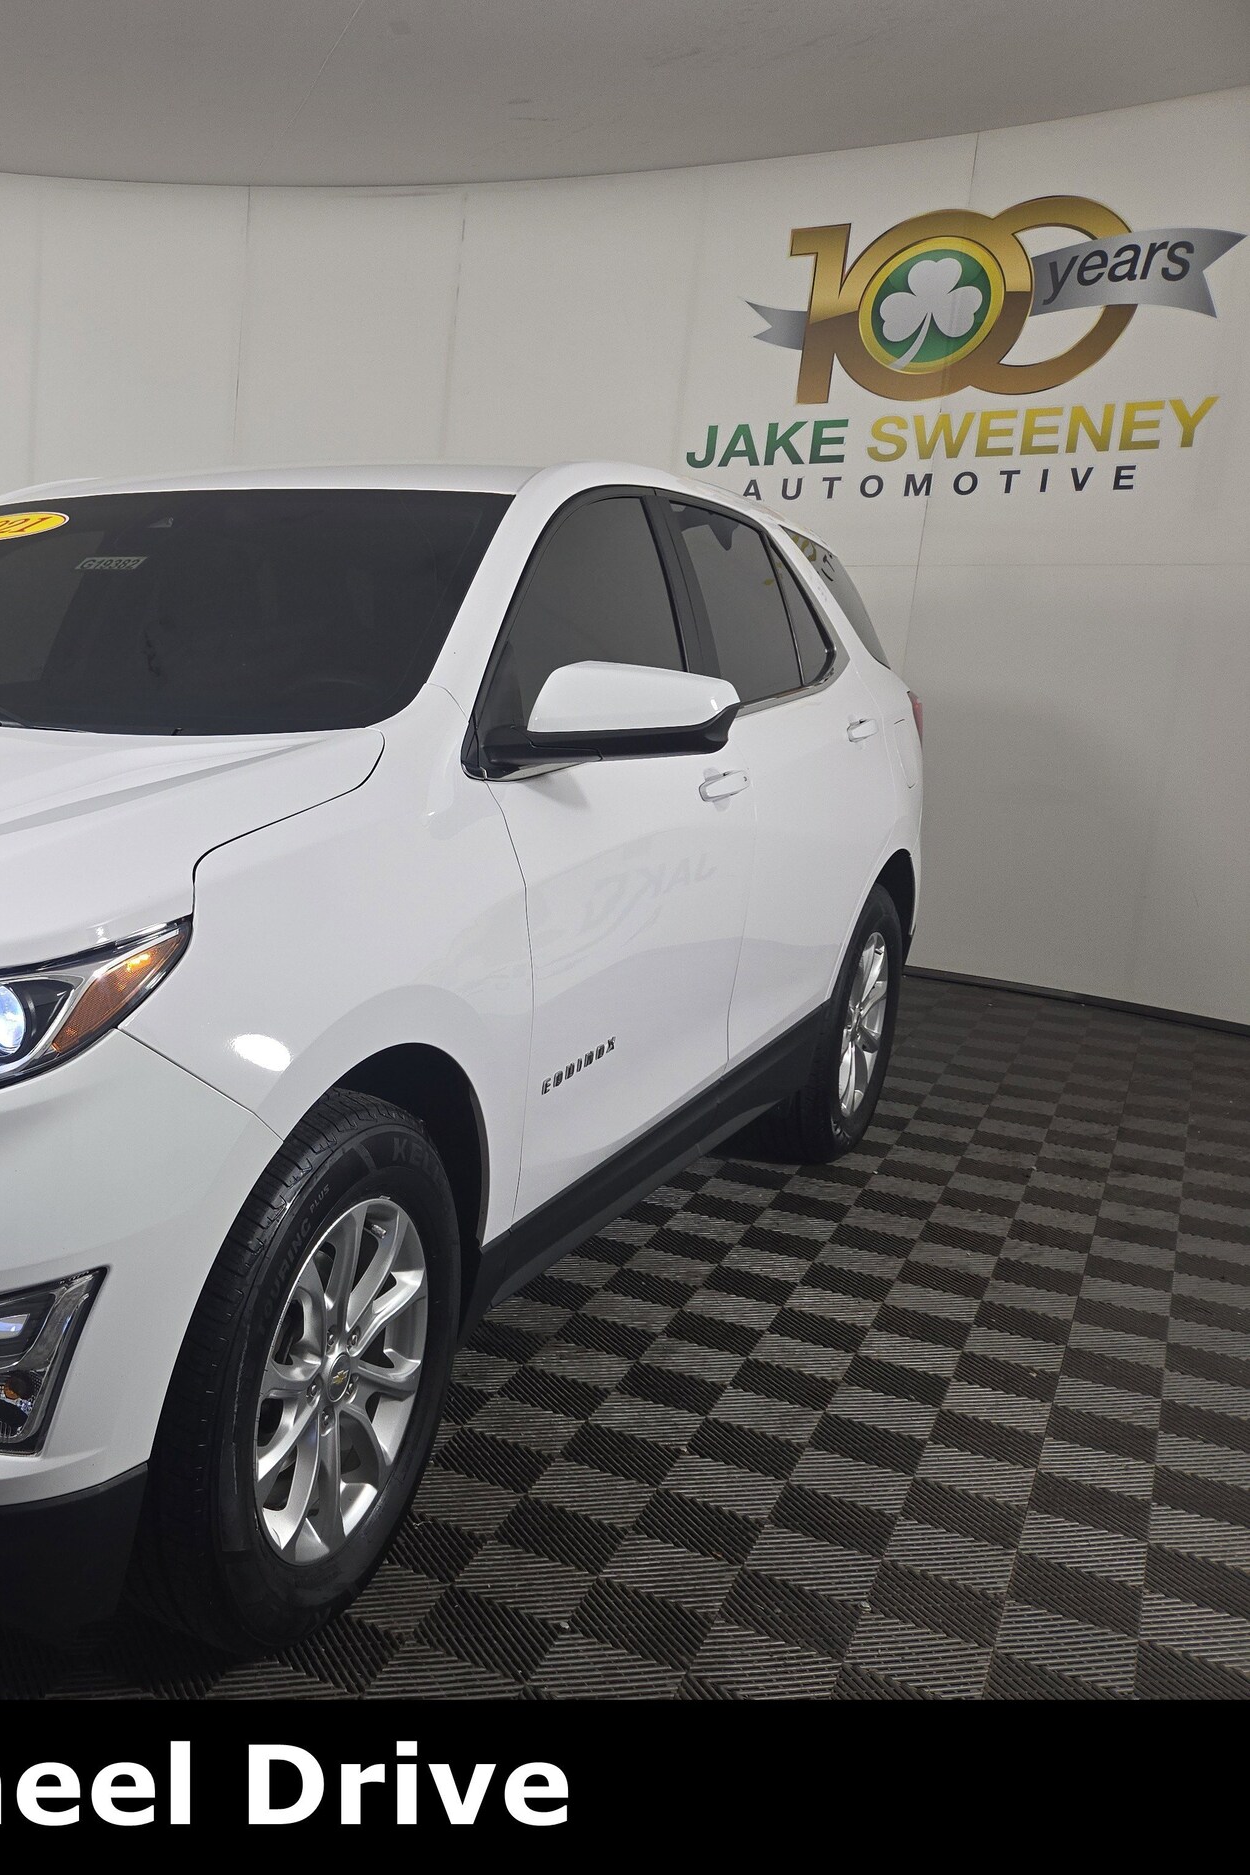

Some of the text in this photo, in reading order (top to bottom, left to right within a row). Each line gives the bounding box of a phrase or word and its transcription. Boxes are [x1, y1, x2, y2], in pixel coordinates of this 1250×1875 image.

[1042, 240, 1195, 305] years
[686, 396, 1220, 469] JAKE SWEENEY
[742, 464, 1138, 502] AUTOMOTIVE
[541, 1036, 617, 1096] EQUINOX
[310, 1183, 330, 1214] PLUS
